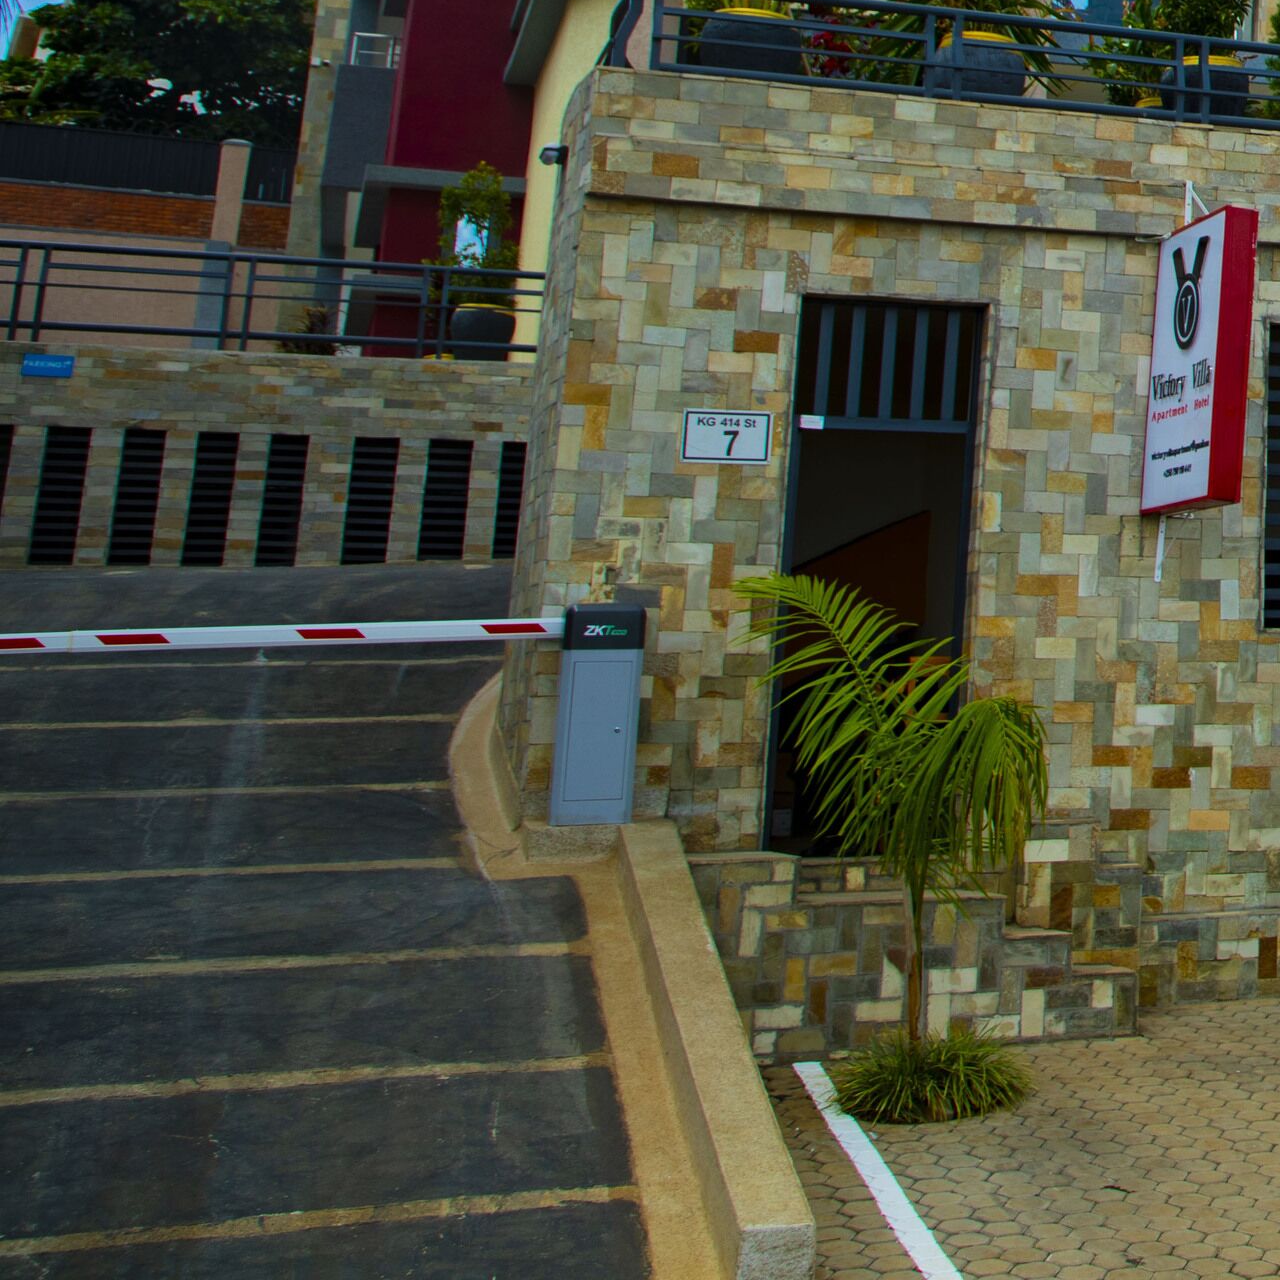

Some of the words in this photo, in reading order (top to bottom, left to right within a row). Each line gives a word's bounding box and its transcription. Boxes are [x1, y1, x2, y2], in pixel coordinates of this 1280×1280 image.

[1152, 373, 1187, 403] Victory
[1192, 357, 1211, 389] Villa
[697, 417, 716, 426] KG
[720, 417, 740, 427] 414
[744, 418, 757, 428] St
[1151, 404, 1189, 424] Apartment
[1193, 394, 1210, 410] Hotel
[723, 430, 740, 457] 7
